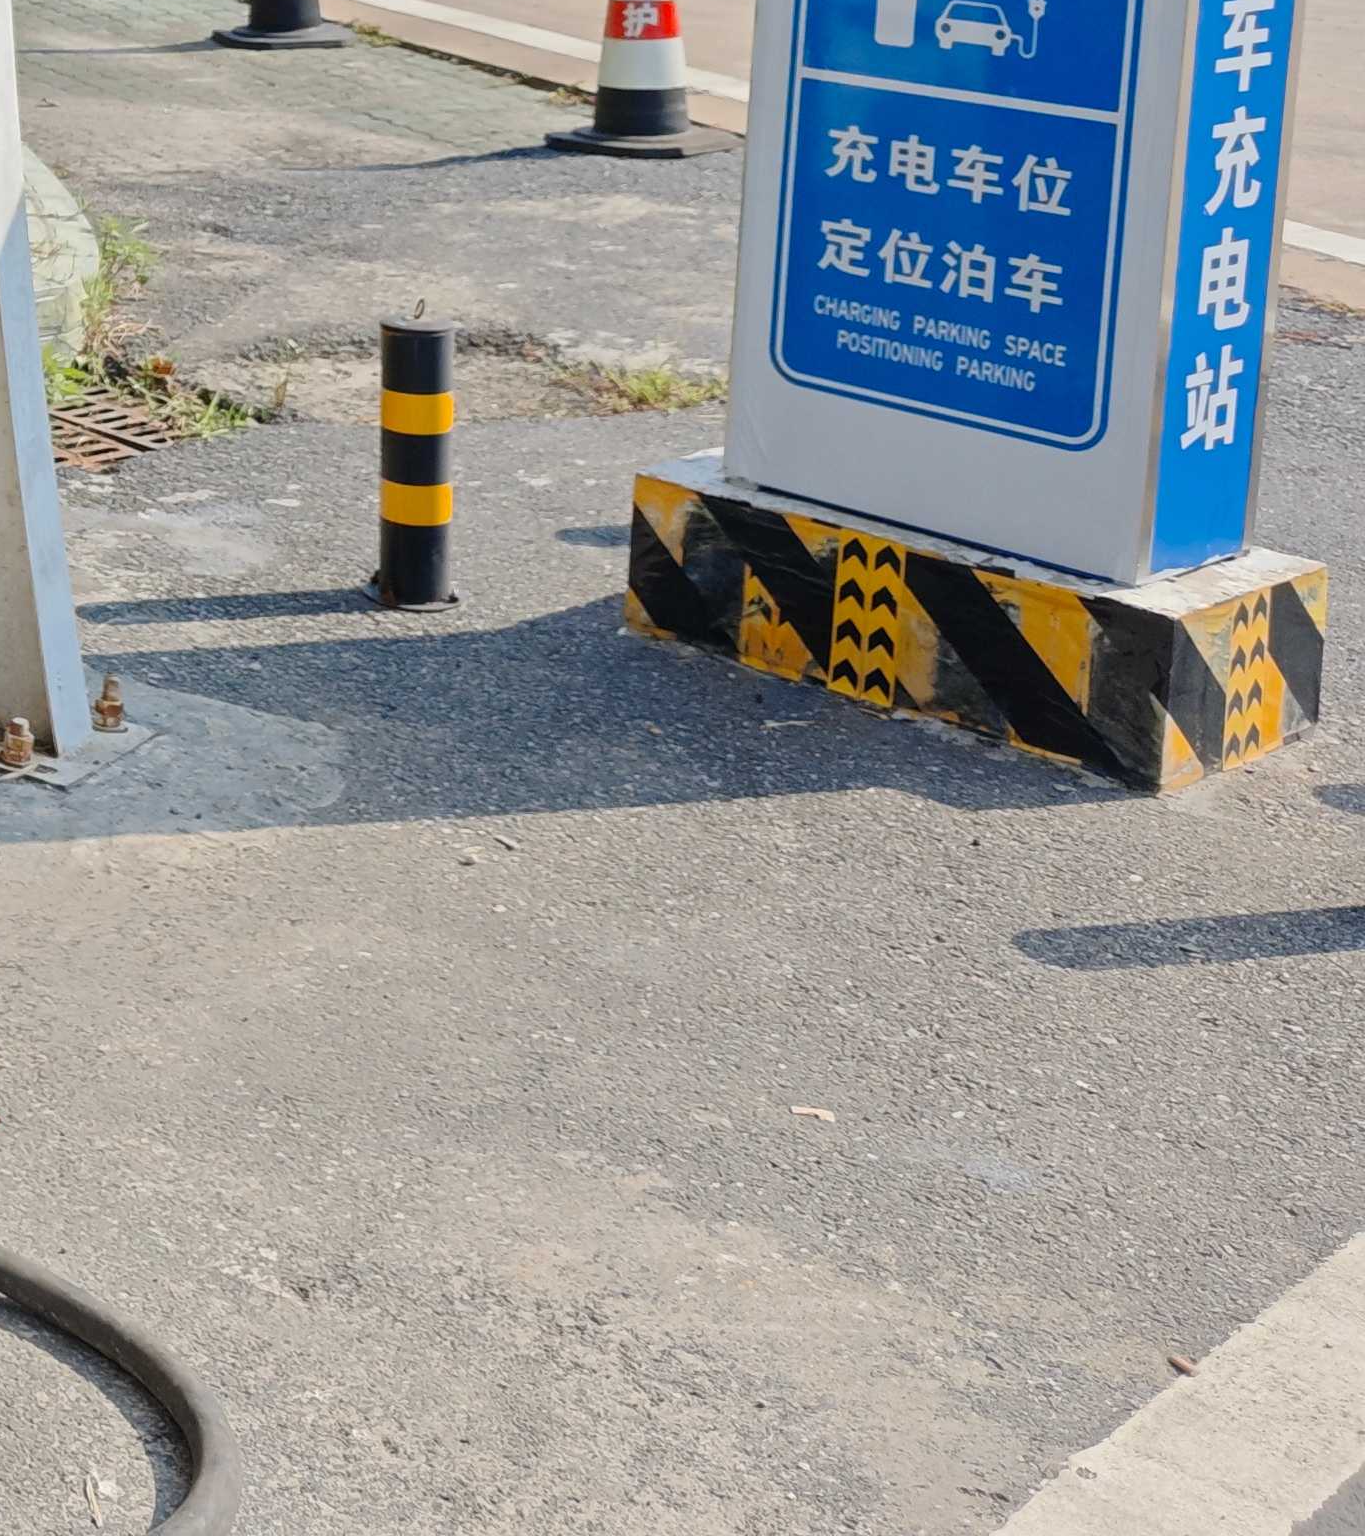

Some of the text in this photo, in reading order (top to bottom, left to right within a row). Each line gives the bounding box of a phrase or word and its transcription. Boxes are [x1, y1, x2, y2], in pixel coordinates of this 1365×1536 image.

[824, 125, 1073, 217] 充电车位
[817, 218, 1065, 314] 定位泊车
[813, 294, 1067, 367] CHARGING PARKING SPACE
[836, 328, 1036, 392] POSITIONING PARKING
